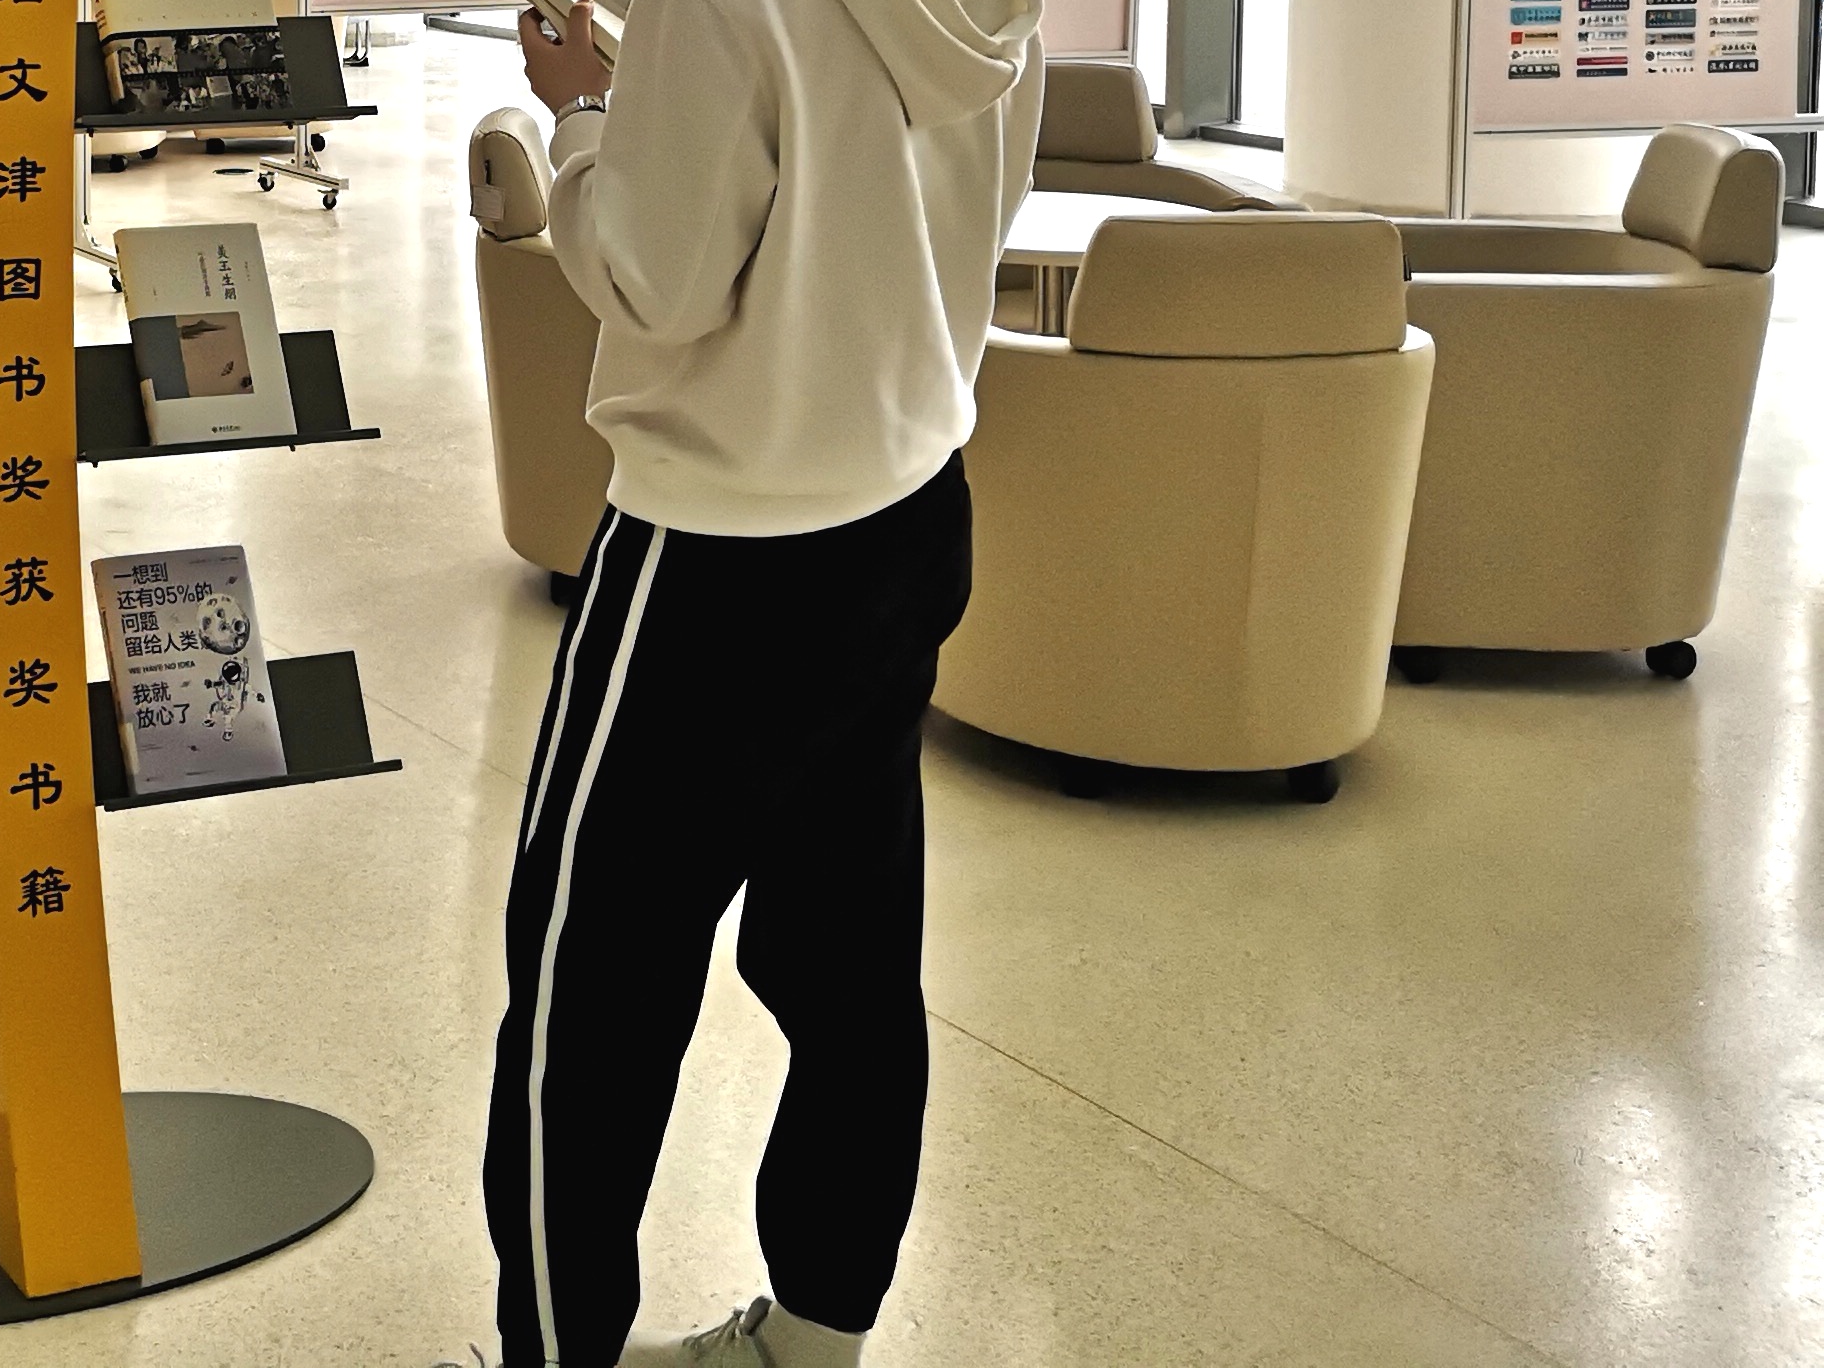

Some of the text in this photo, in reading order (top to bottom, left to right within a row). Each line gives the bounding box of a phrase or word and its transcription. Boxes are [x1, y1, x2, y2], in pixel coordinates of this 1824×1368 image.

[113, 562, 169, 585] 一想到
[117, 582, 213, 610] 还有95%的
[121, 613, 159, 634] 问题
[133, 681, 171, 704] 我就
[137, 703, 190, 729] 放心了
